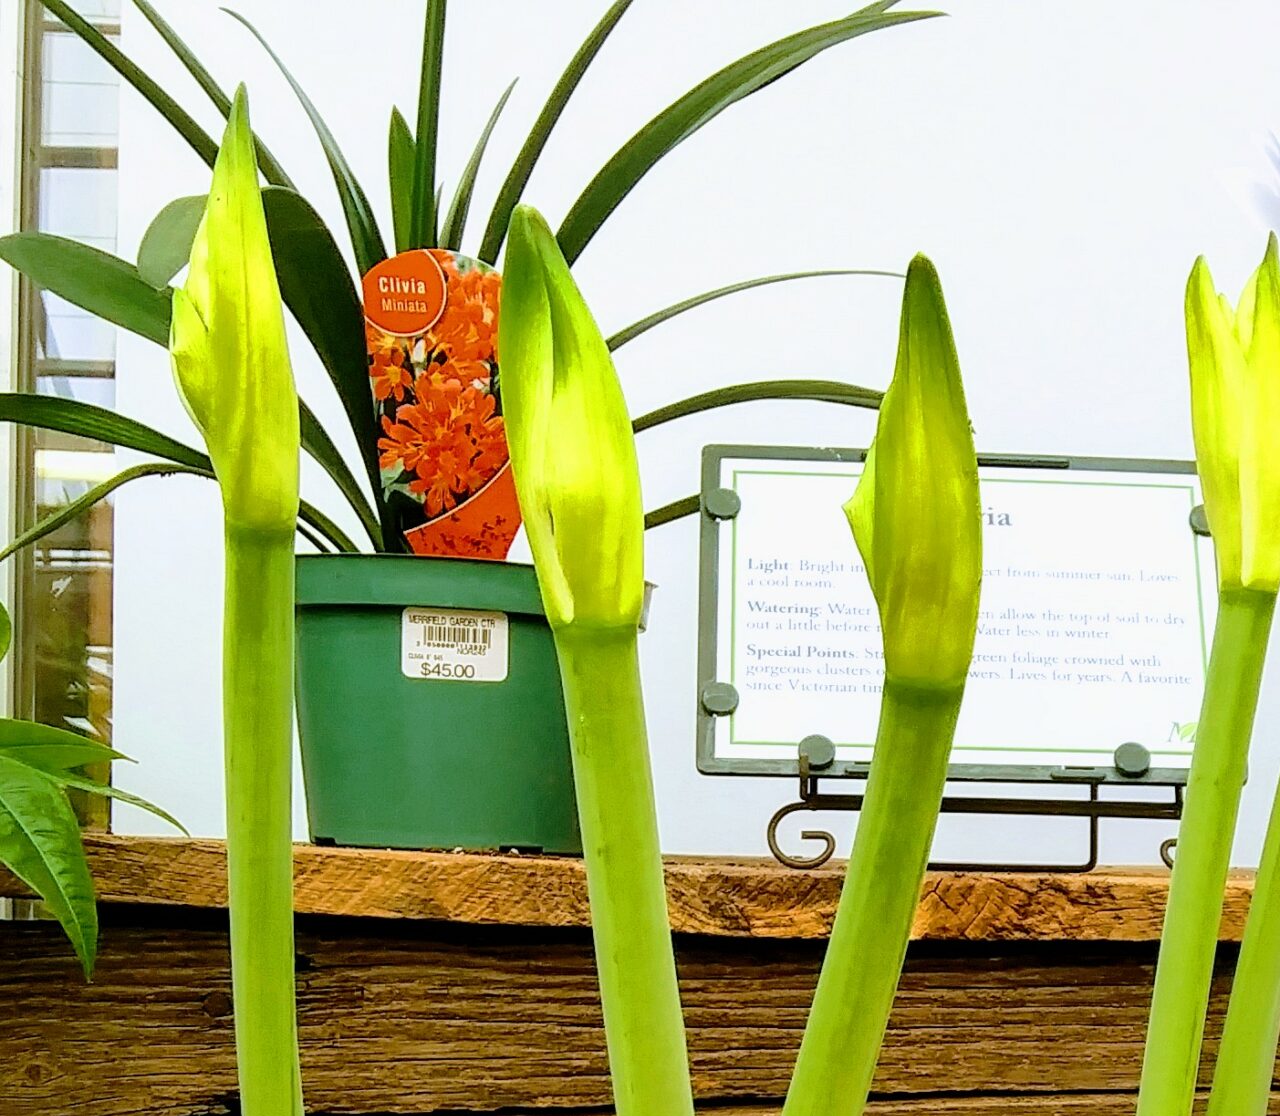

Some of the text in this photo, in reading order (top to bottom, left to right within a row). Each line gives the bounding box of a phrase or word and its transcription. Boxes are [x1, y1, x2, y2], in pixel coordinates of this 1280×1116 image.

[378, 276, 426, 294] Clivia
[382, 298, 428, 313] Miniata
[799, 559, 844, 574] Bright
[1007, 567, 1040, 578] from
[1140, 570, 1180, 582] Loves
[747, 579, 754, 587] a
[759, 576, 789, 587] cool
[408, 615, 496, 628] MERRIFIELD GARDEN CTR
[828, 602, 872, 616] Water
[999, 608, 1036, 621] allow
[1042, 609, 1066, 621] the
[1069, 611, 1091, 625] top
[1115, 612, 1140, 624] soil
[746, 619, 770, 630] out
[788, 618, 821, 632] little
[826, 619, 875, 632] before
[1016, 625, 1041, 637] less
[1046, 626, 1060, 638] in
[746, 643, 801, 660] Special
[1012, 652, 1059, 667] foliage
[1064, 653, 1124, 667] crowned
[1130, 655, 1161, 667] with
[420, 661, 476, 679] $45.00
[746, 664, 812, 677] gorgeous
[817, 663, 871, 676] clusters
[1010, 667, 1046, 681] Lives
[1053, 668, 1072, 681] for
[1121, 671, 1133, 684] A
[1138, 670, 1192, 685] favorite
[746, 680, 783, 691] since
[788, 679, 857, 692] Victorian
